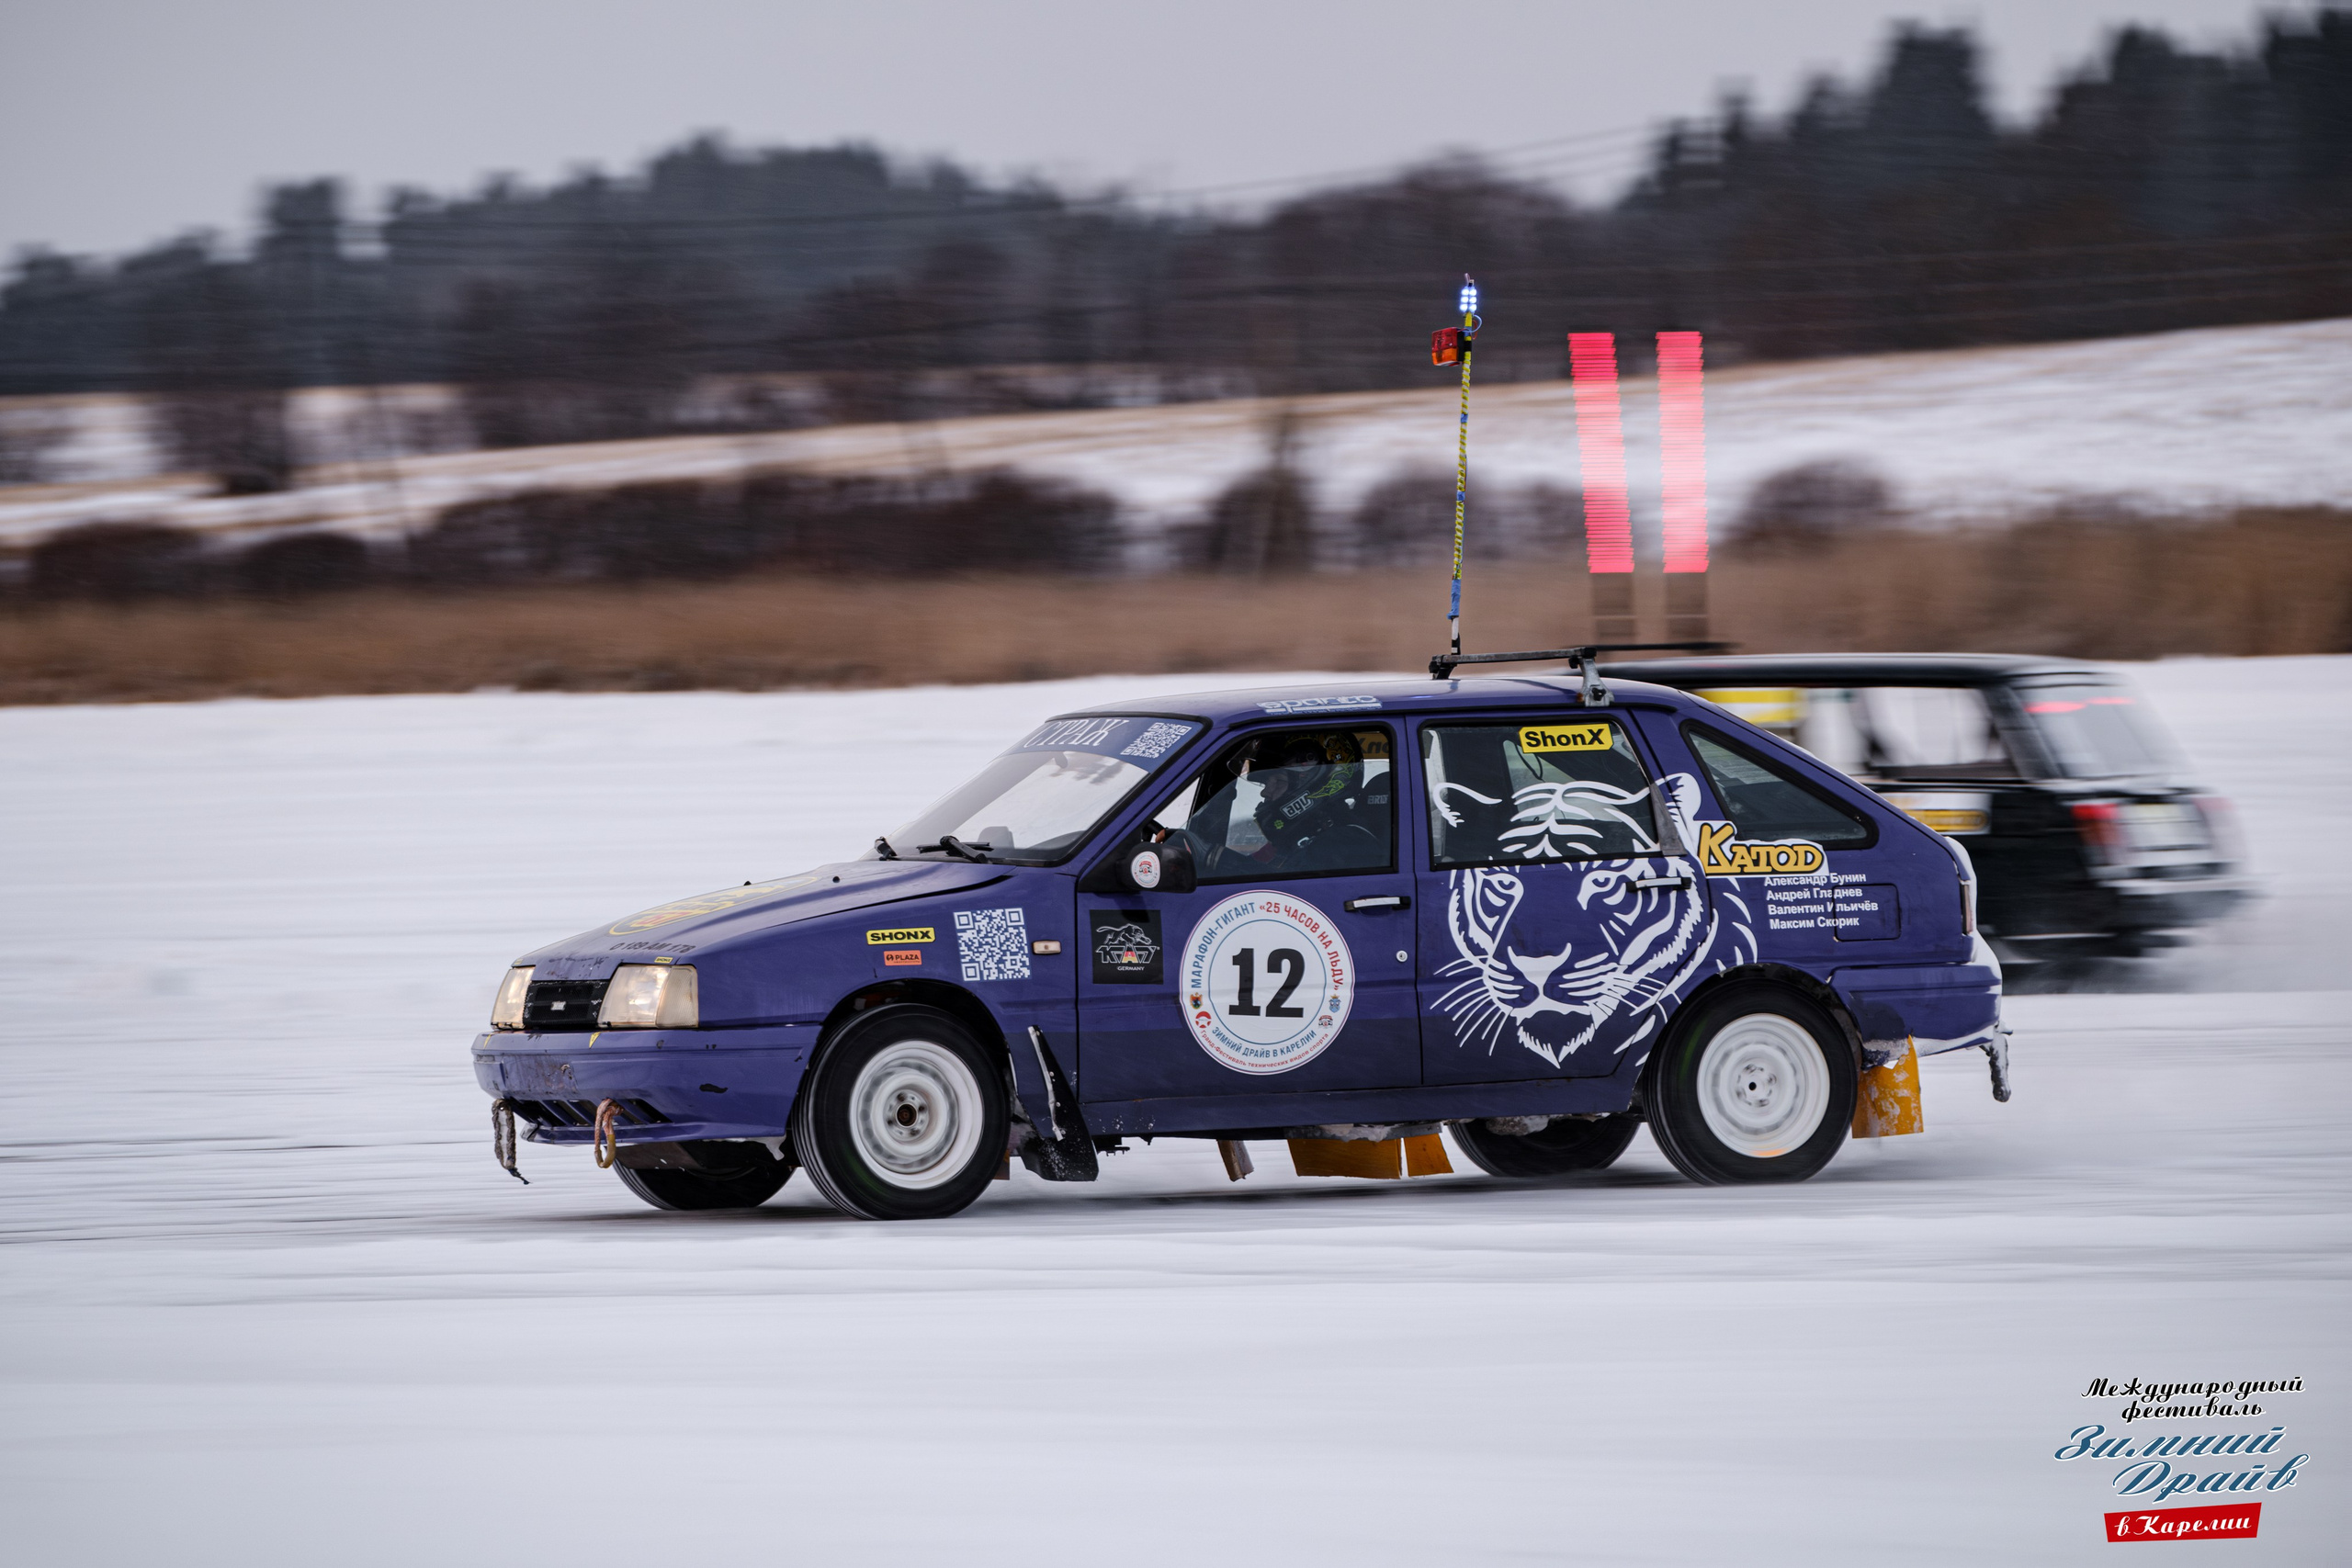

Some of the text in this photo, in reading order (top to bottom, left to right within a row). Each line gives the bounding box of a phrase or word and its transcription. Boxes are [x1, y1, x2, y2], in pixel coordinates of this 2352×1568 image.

[1257, 695, 1378, 713] sparco
[1023, 718, 1129, 749] СТРАЖ
[1524, 728, 1605, 748] ShonX
[1764, 873, 1866, 887] Александр Бунин
[1767, 886, 1863, 901] Андрей Гладнев
[1768, 899, 1879, 916] Валентин Ильичёв
[1770, 915, 1860, 930] Максим Скорик
[870, 931, 932, 942] SHONX
[1191, 902, 1256, 988] МАРАФОН-ГИГАНТ
[1284, 905, 1319, 933] ЧАСОВ
[1317, 931, 1333, 950] НА
[1228, 947, 1305, 1019] 12
[1212, 1026, 1317, 1058] ЗИМНИЙ ДРАЙВ В КАРЕЛИИ
[1248, 1060, 1289, 1068] технических
[1289, 1050, 1310, 1063] видов
[1309, 1033, 1329, 1052] спорта
